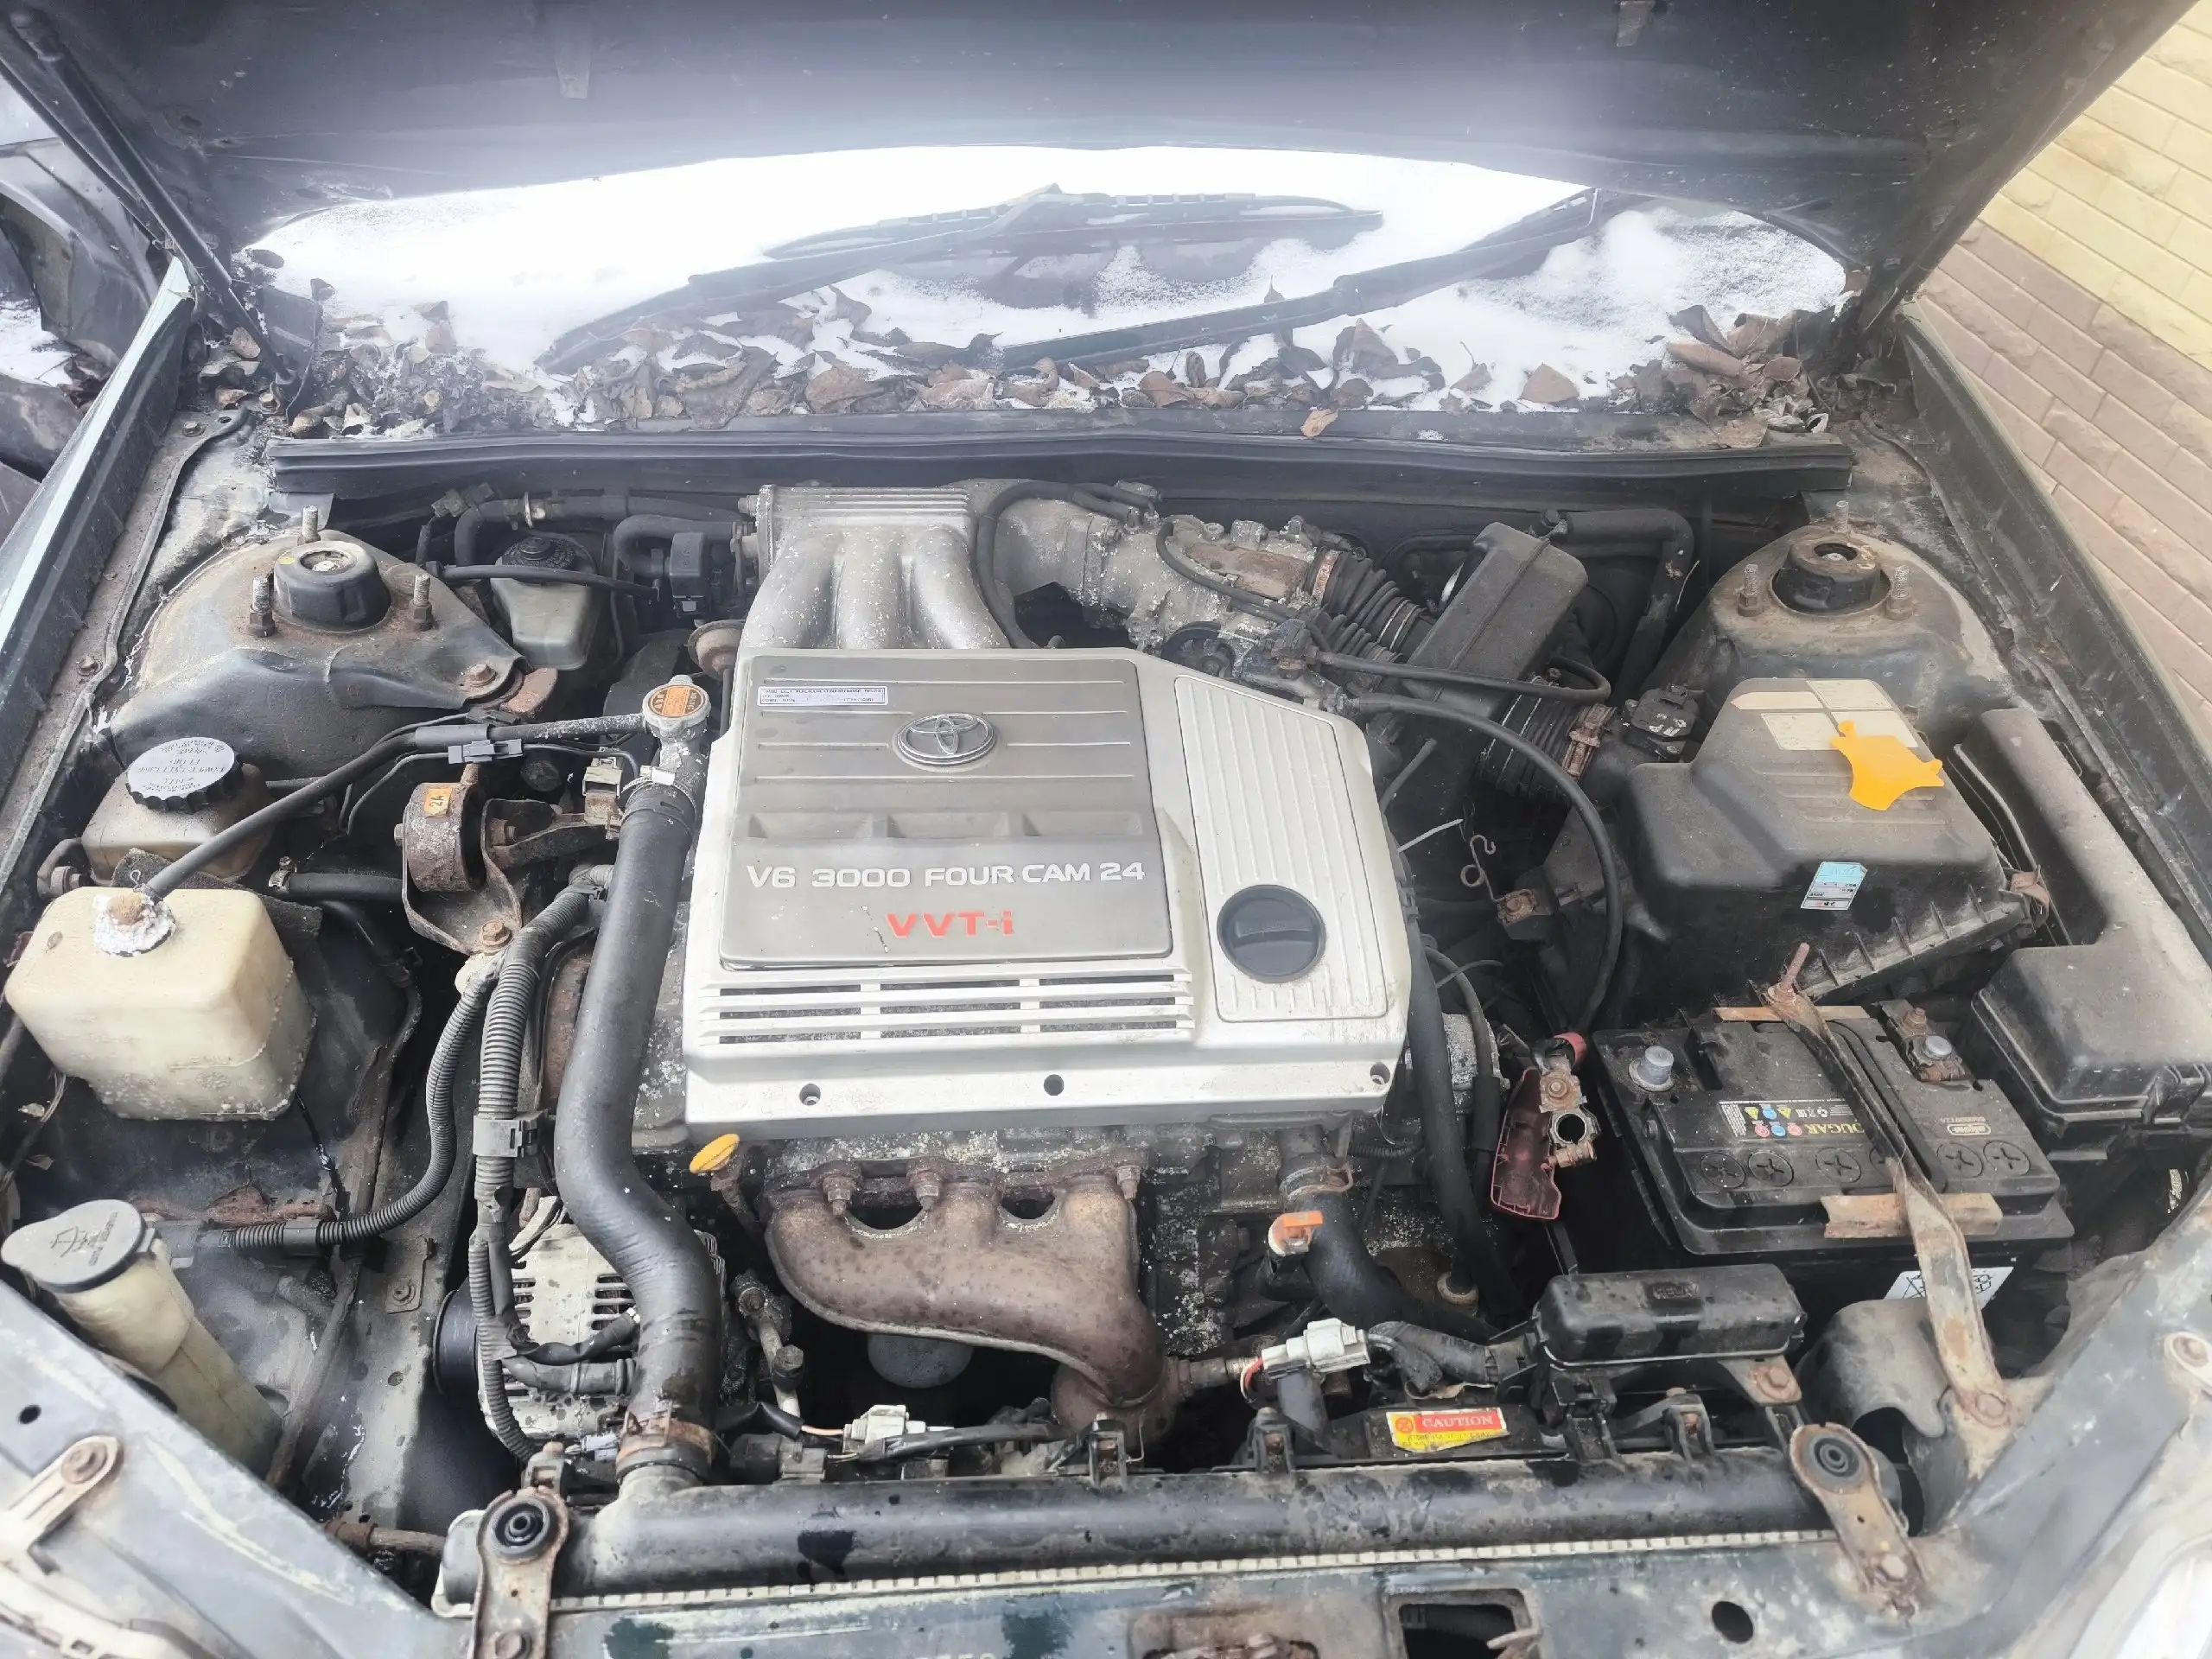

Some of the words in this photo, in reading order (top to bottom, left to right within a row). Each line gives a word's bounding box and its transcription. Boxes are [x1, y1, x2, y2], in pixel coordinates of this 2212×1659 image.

[747, 866, 796, 888] V6
[812, 868, 910, 888] 3000
[925, 865, 1015, 887] FOUR
[1022, 863, 1092, 884] CAM
[1100, 861, 1146, 882] 24
[886, 911, 1015, 939] VVT-i
[1804, 1123, 1866, 1135] OUGAR
[1421, 1414, 1494, 1428] CAUTION
